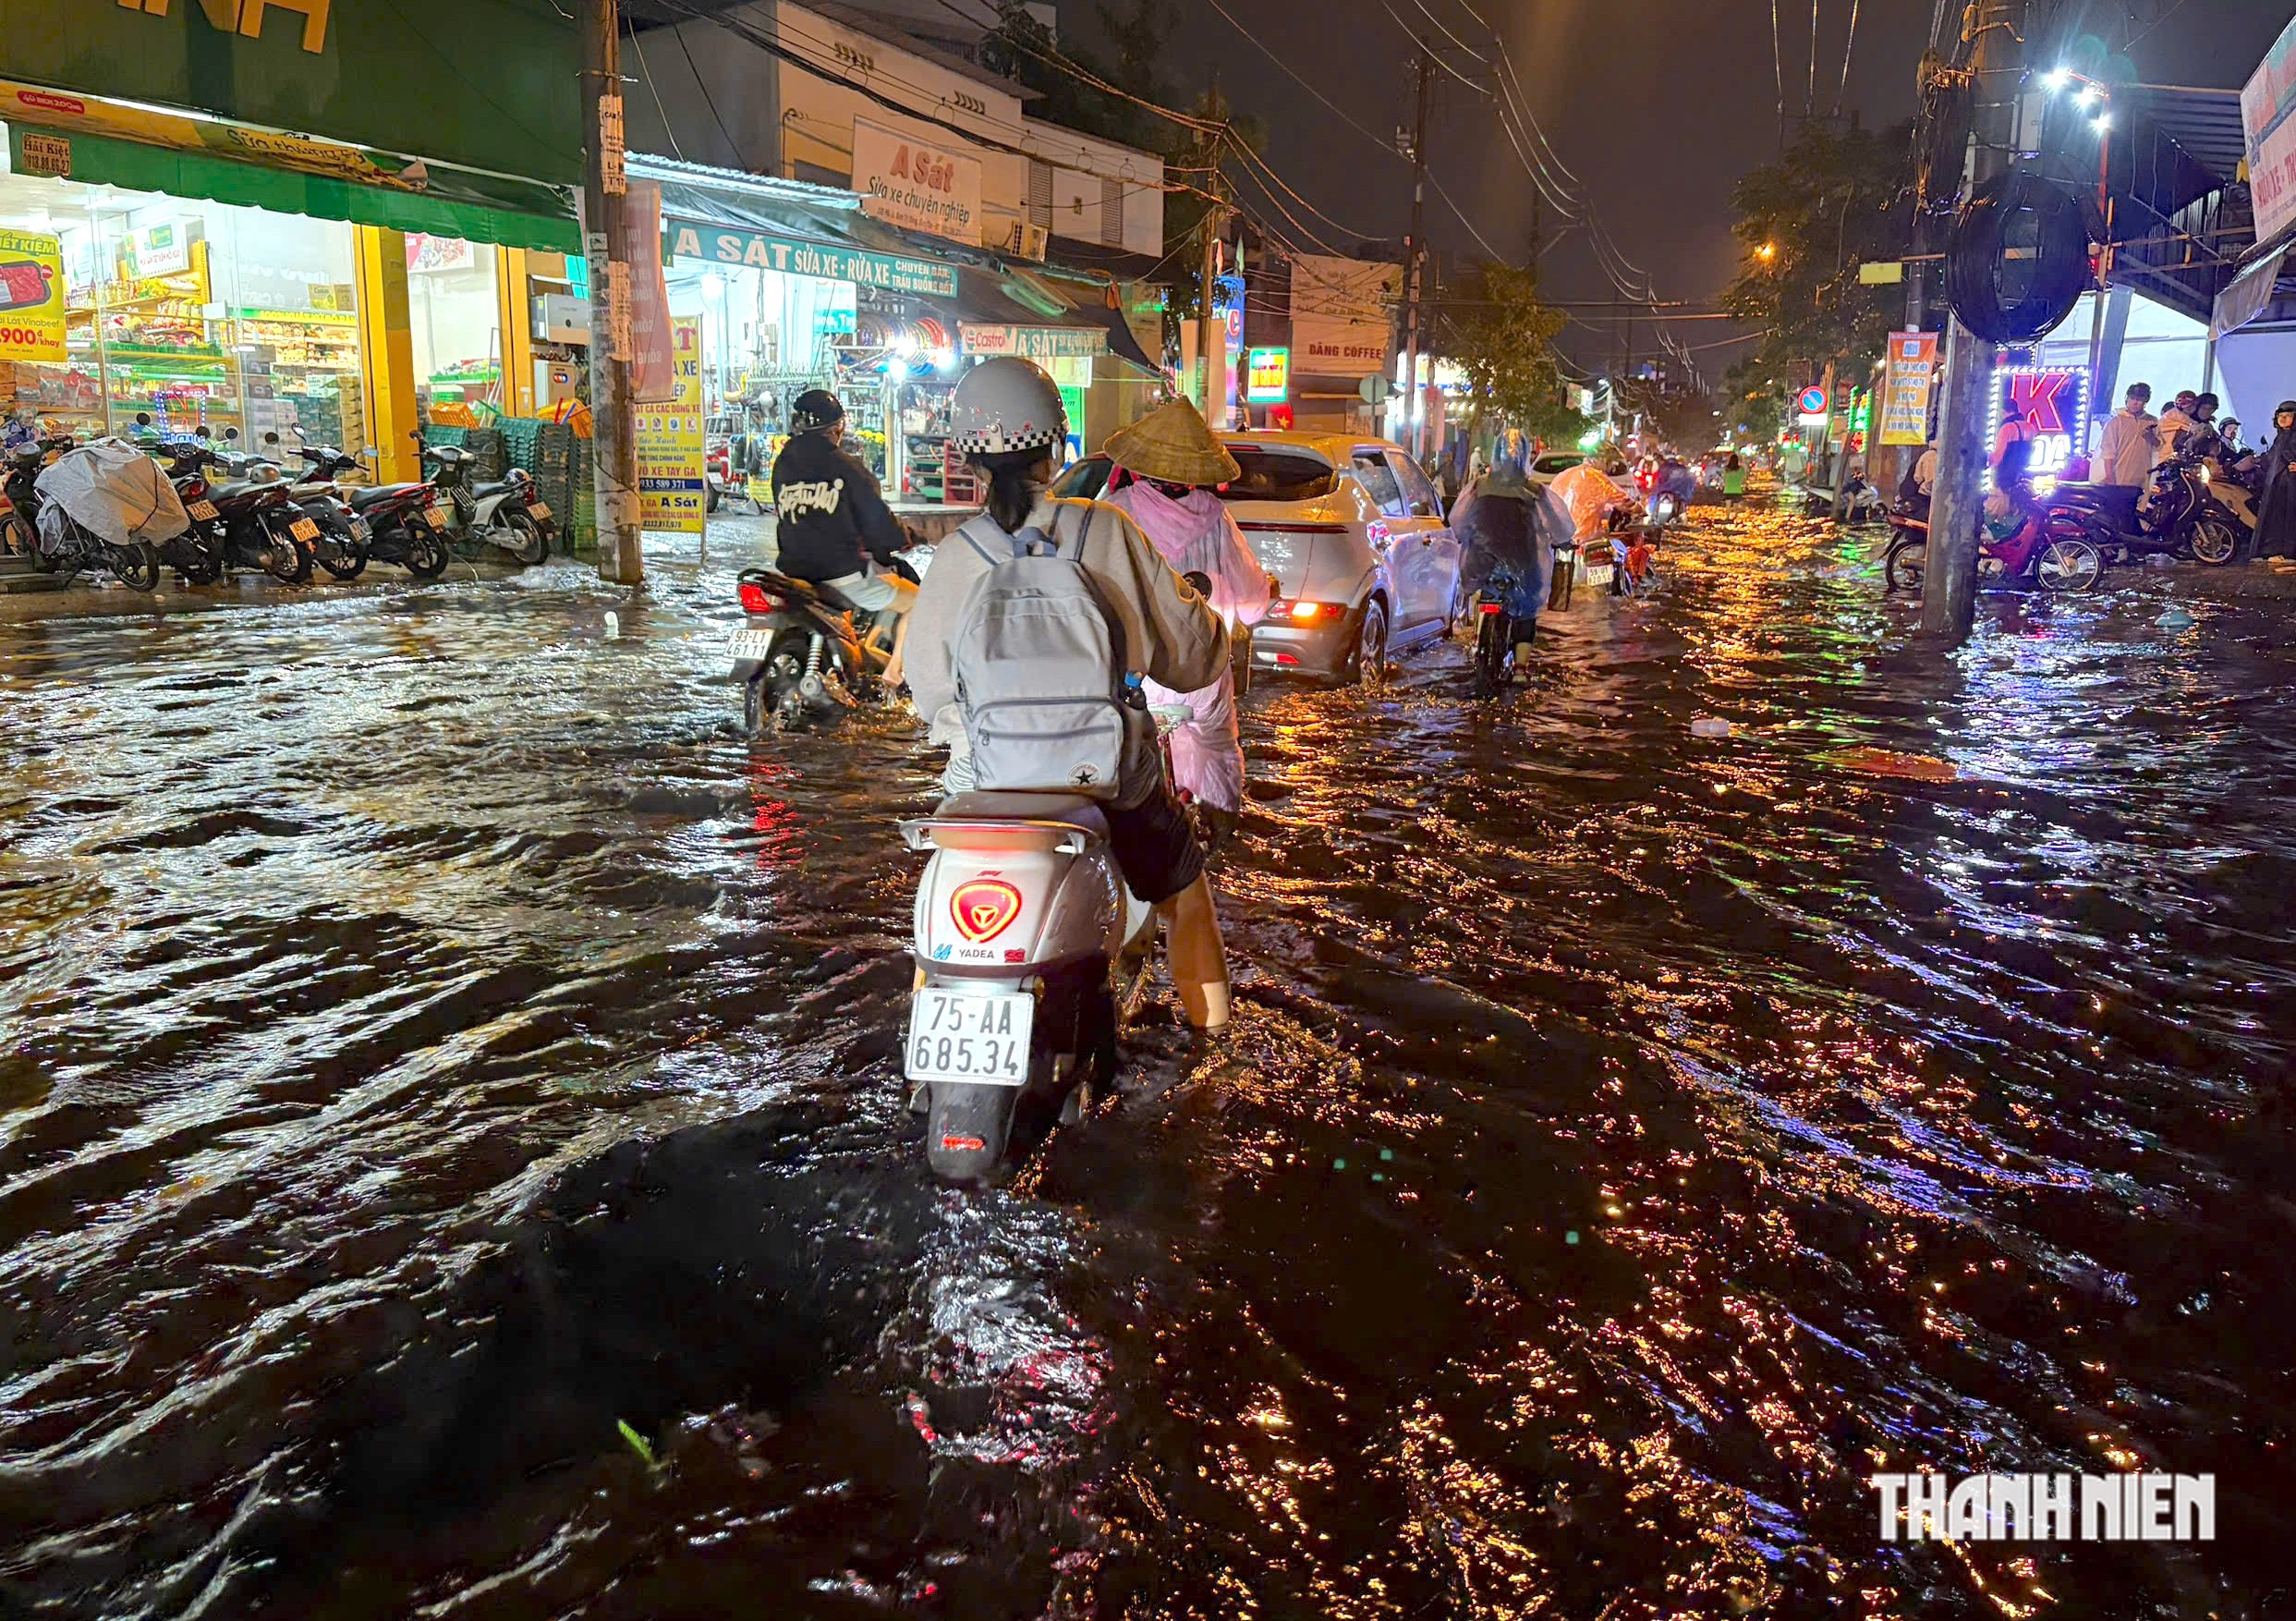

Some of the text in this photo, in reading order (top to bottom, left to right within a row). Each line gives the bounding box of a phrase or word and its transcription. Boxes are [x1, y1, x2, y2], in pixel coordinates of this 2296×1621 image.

[46, 142, 69, 158] Kiệt
[890, 144, 954, 193] A Sát
[868, 176, 888, 200] Sửa
[890, 188, 903, 202] xe
[904, 188, 939, 214] chuyên
[940, 201, 970, 227] nghiệp
[674, 228, 702, 257] A
[717, 235, 792, 270] SÁT
[795, 243, 820, 274] SỬA
[821, 254, 838, 276] XE
[847, 251, 873, 282] RỬA
[874, 262, 890, 285] XE
[23, 318, 59, 328] Vinabeef
[975, 332, 1006, 347] Castrol
[1017, 334, 1028, 356] A
[1031, 330, 1058, 356] SÁT
[1343, 345, 1382, 359] COFFEE
[683, 360, 698, 376] XE
[2011, 372, 2070, 433] K
[651, 467, 663, 476] XE
[665, 467, 681, 476] TAY
[685, 467, 696, 477] GA
[672, 481, 686, 489] 371
[661, 497, 671, 507] A
[674, 496, 698, 507] Sát
[735, 630, 766, 643] 93-L1
[726, 643, 766, 657] 461.11
[959, 949, 995, 958] YADEA
[930, 996, 1012, 1035] 75-AA
[915, 1036, 1019, 1076] 685.34
